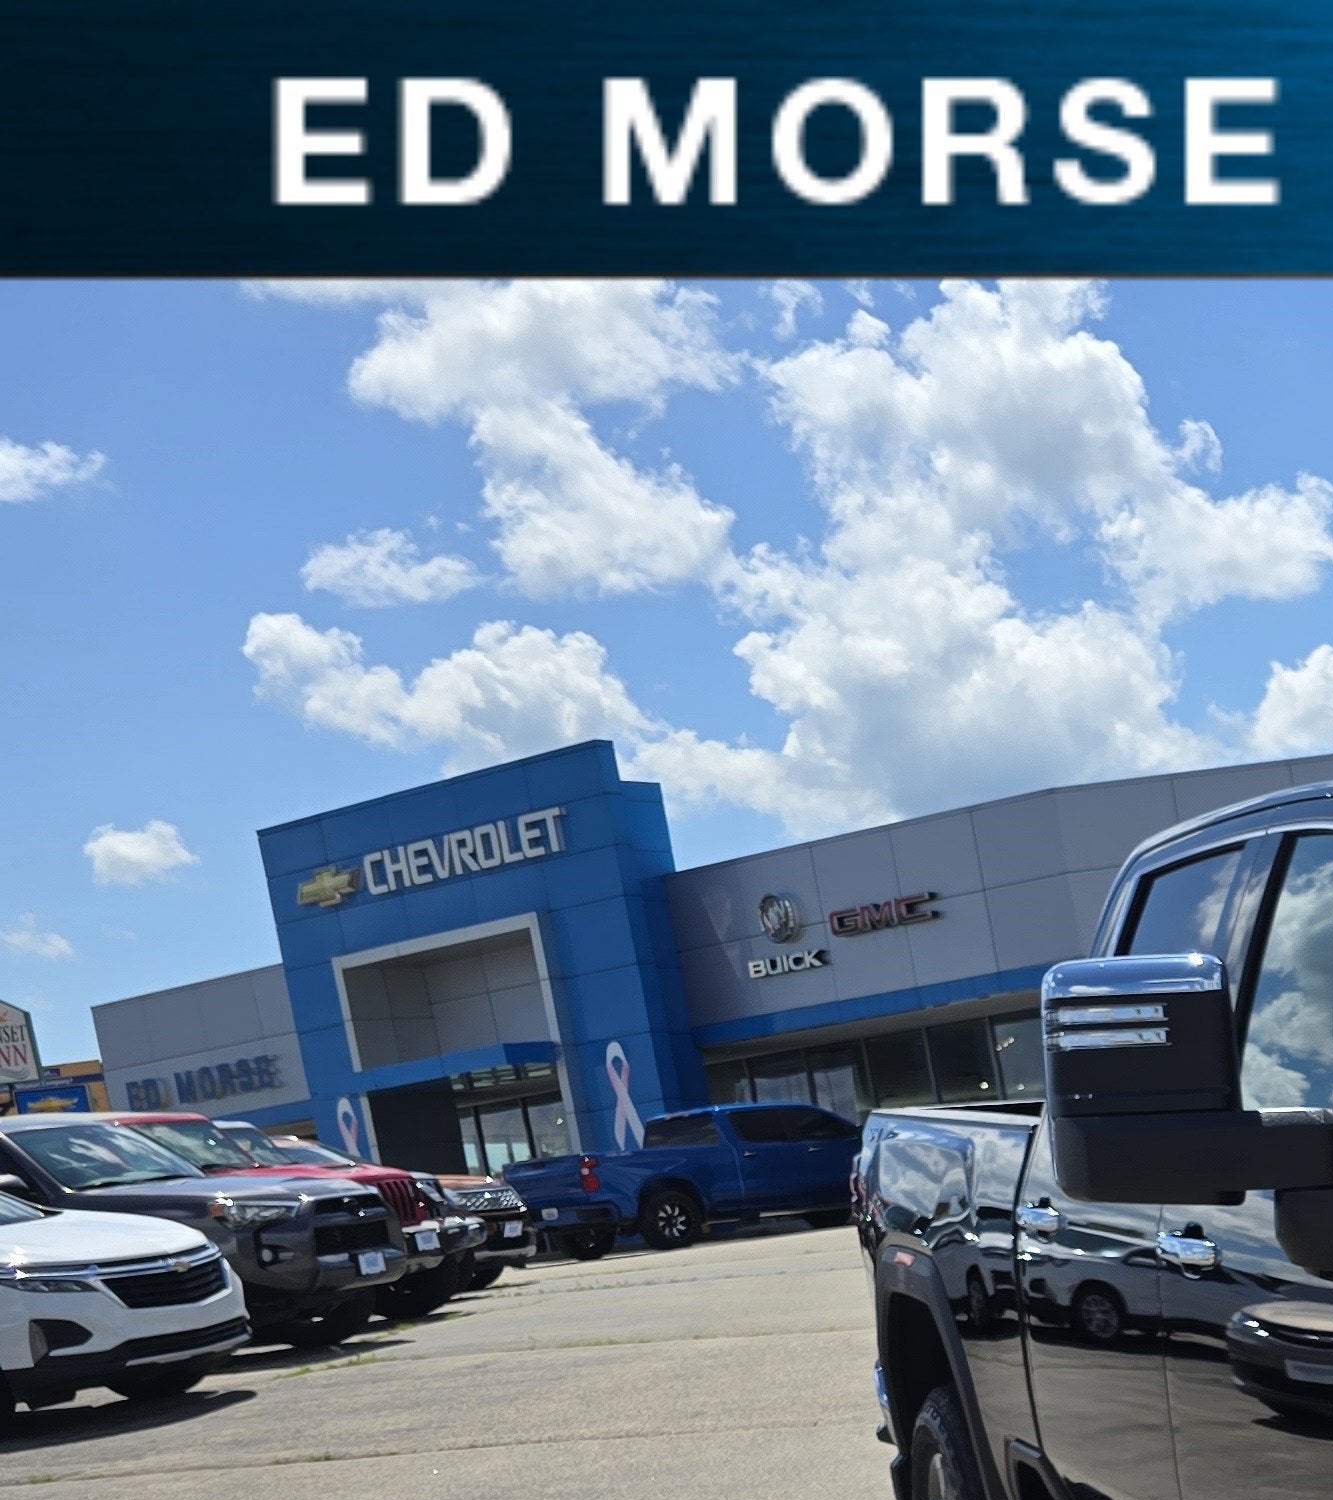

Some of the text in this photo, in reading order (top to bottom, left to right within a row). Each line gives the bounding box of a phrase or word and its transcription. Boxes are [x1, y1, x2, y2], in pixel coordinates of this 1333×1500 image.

[363, 806, 565, 896] CHEVROLET
[829, 892, 935, 938] GMC
[748, 949, 824, 979] BUICK
[0, 1024, 26, 1043] SET
[125, 1054, 280, 1112] ED MORSE
